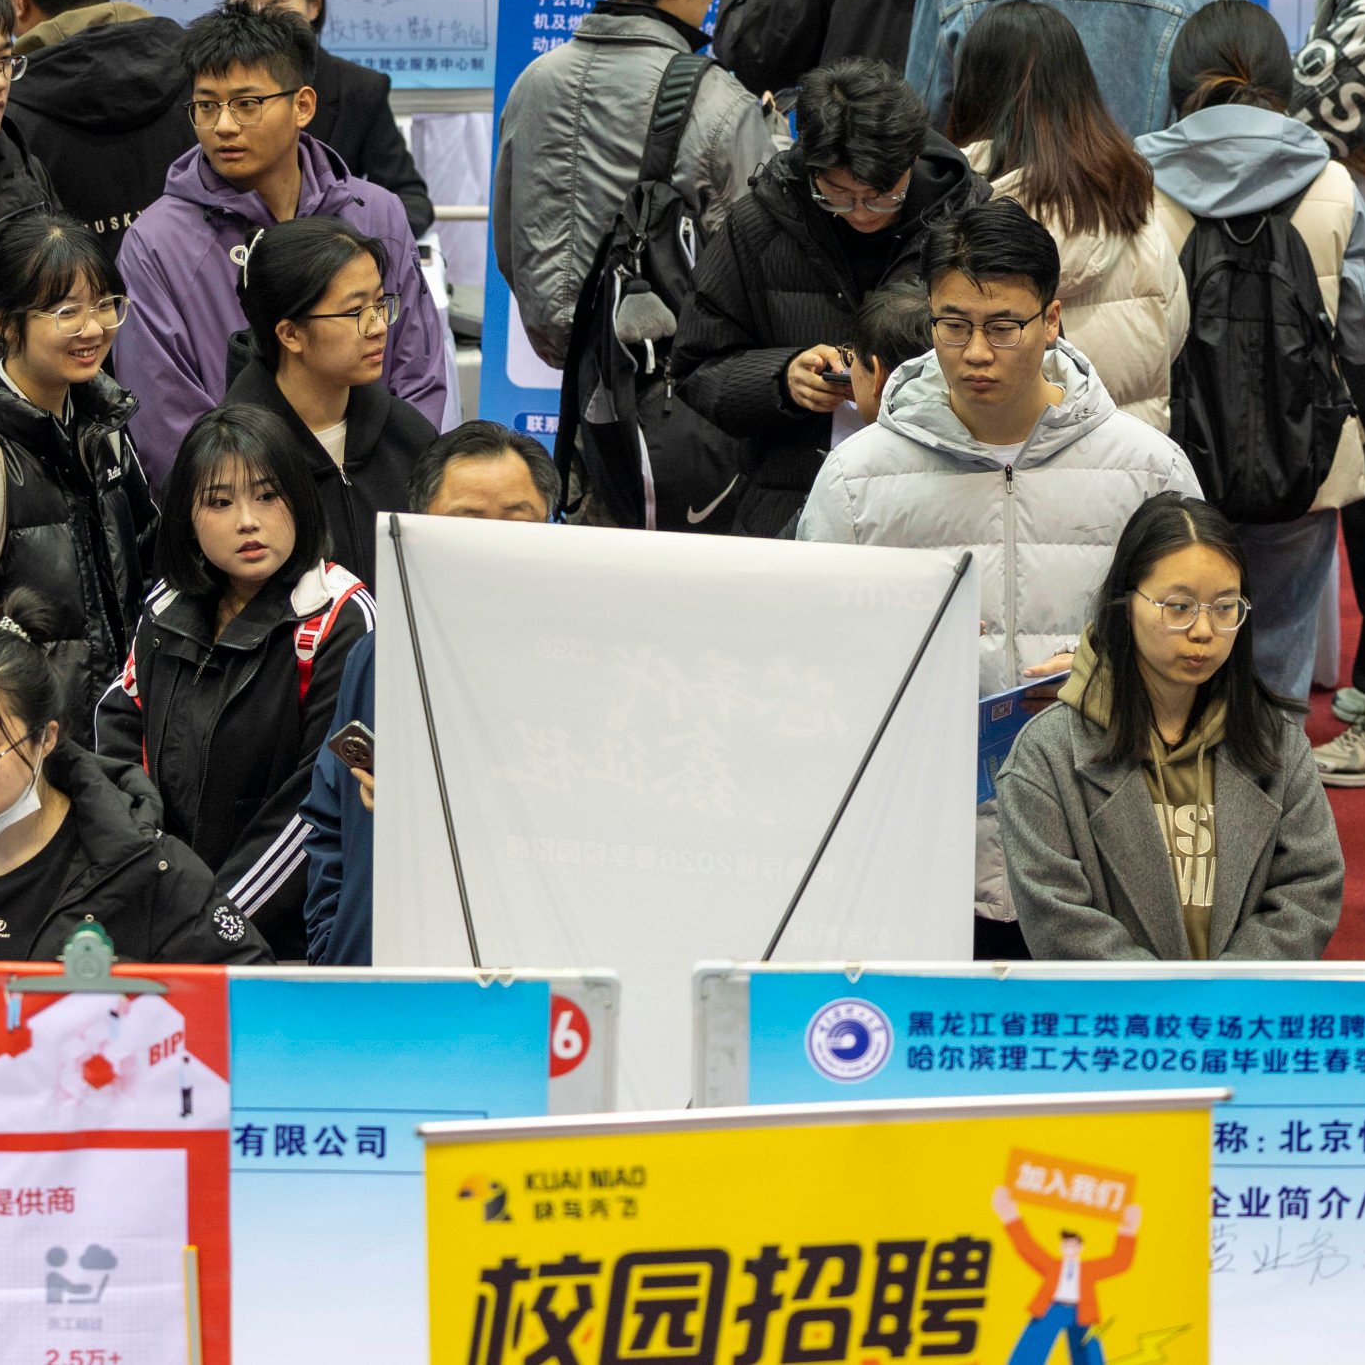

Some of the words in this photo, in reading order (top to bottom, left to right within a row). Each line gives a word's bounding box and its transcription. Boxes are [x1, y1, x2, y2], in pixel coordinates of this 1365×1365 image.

[148, 1032, 184, 1067] BIP
[233, 1124, 388, 1159] 有限公司
[524, 1168, 583, 1193] KUAI
[1013, 1162, 1127, 1213] 加入我们
[466, 1236, 994, 1365] 校园招聘
